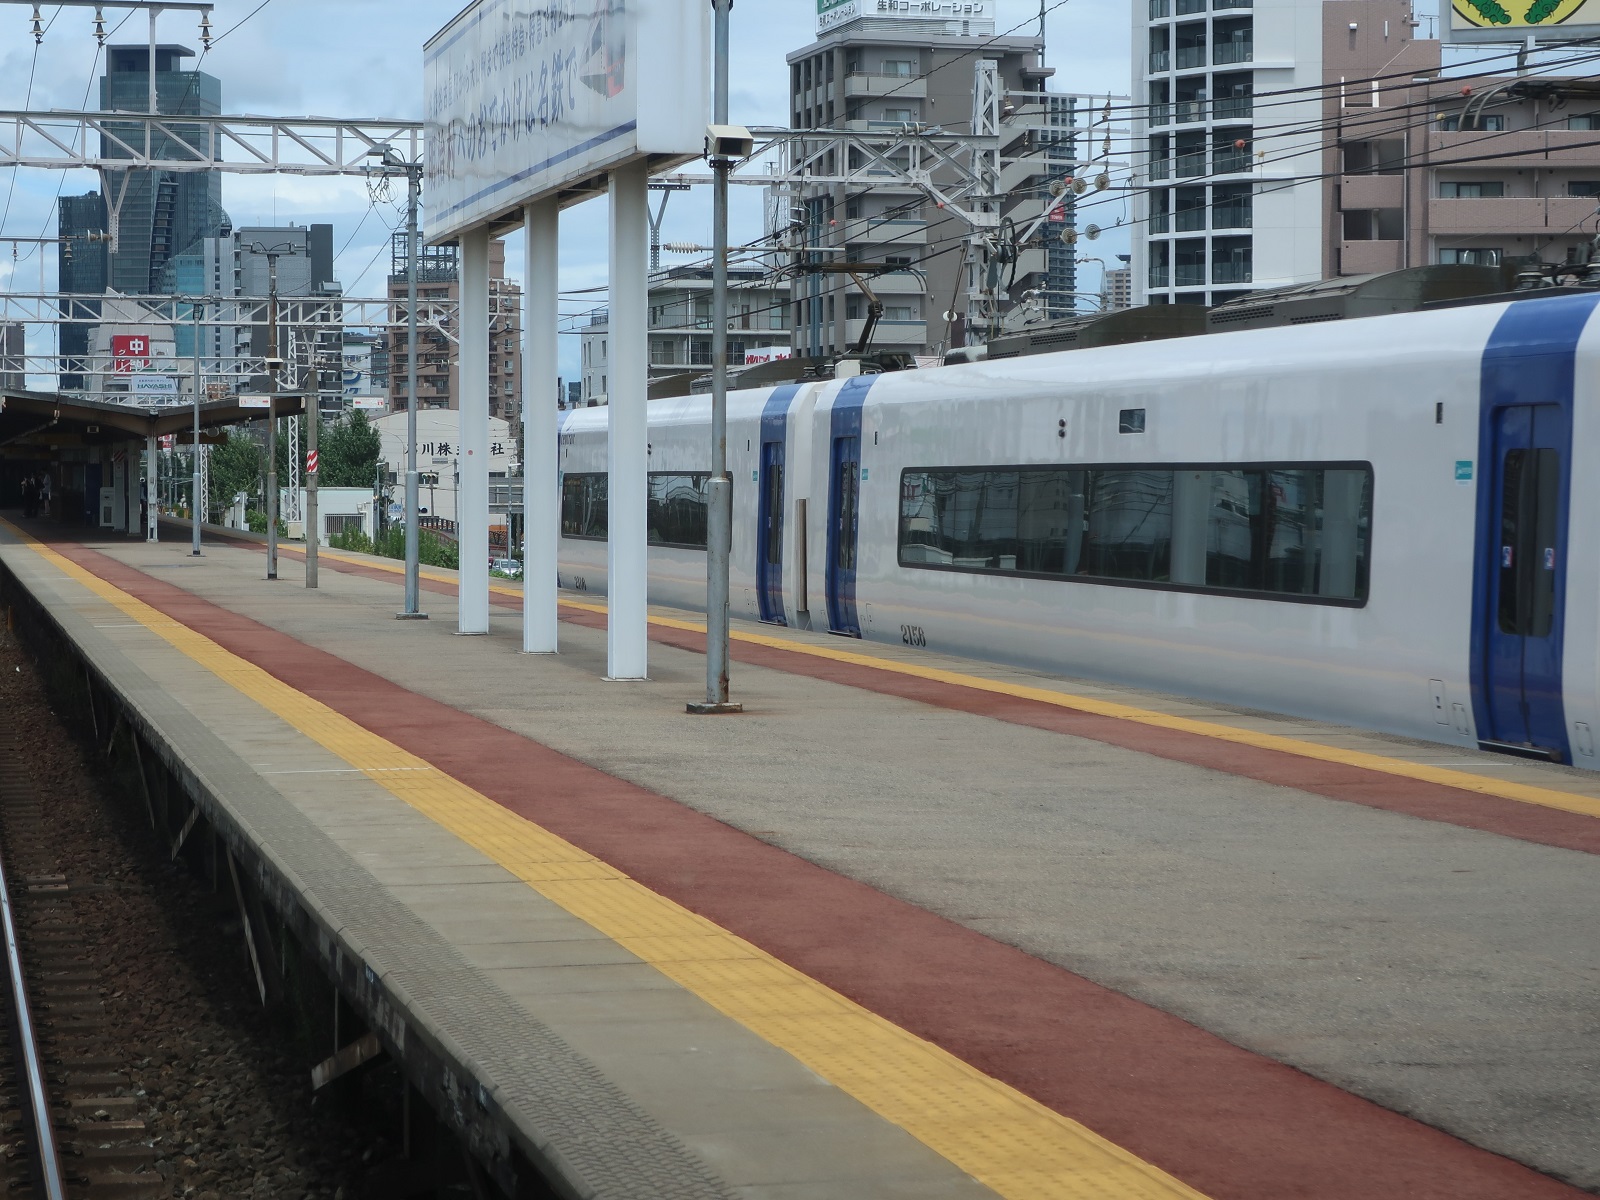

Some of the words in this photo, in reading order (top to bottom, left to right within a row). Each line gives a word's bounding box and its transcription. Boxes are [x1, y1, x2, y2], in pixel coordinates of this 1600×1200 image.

[877, 0, 984, 13] 生和コーポレーション
[405, 441, 505, 457] 川株社
